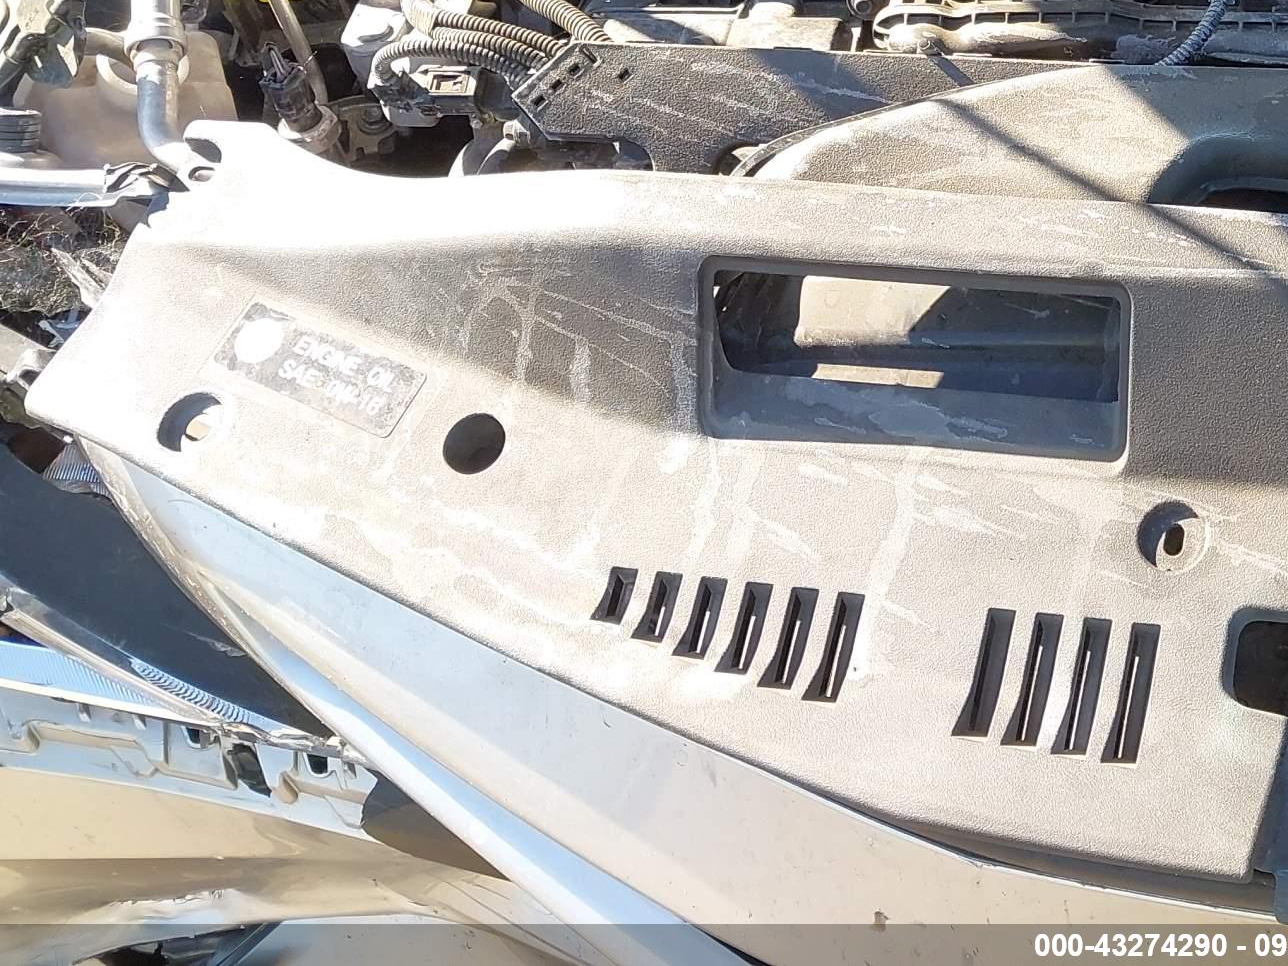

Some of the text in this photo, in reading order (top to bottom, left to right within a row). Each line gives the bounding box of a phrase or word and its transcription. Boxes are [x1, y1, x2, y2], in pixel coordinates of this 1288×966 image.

[278, 358, 321, 389] SAE
[292, 334, 396, 394] ENGINE OIL
